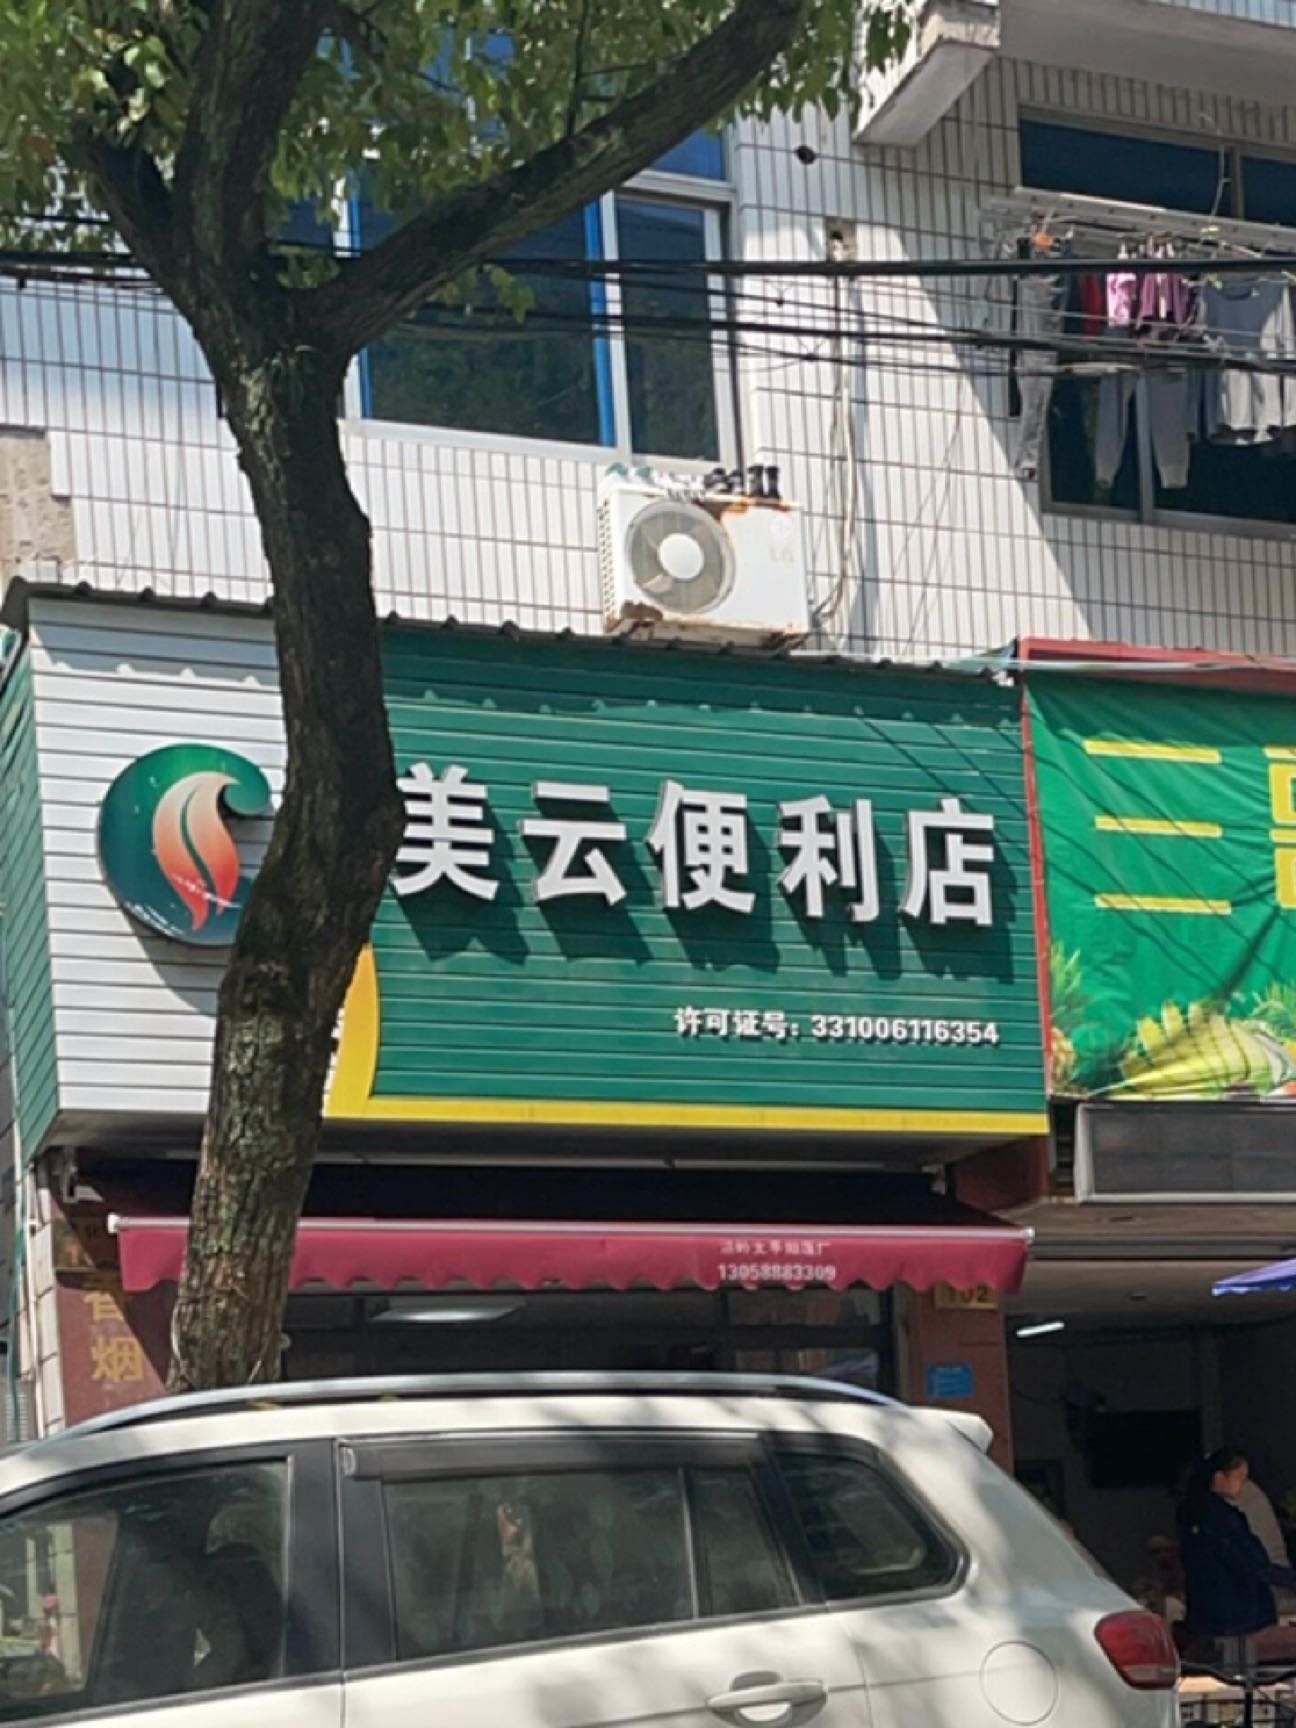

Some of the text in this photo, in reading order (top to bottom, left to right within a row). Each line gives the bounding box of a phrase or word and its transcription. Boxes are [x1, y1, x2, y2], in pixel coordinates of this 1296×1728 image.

[393, 760, 996, 929] 美云便利店
